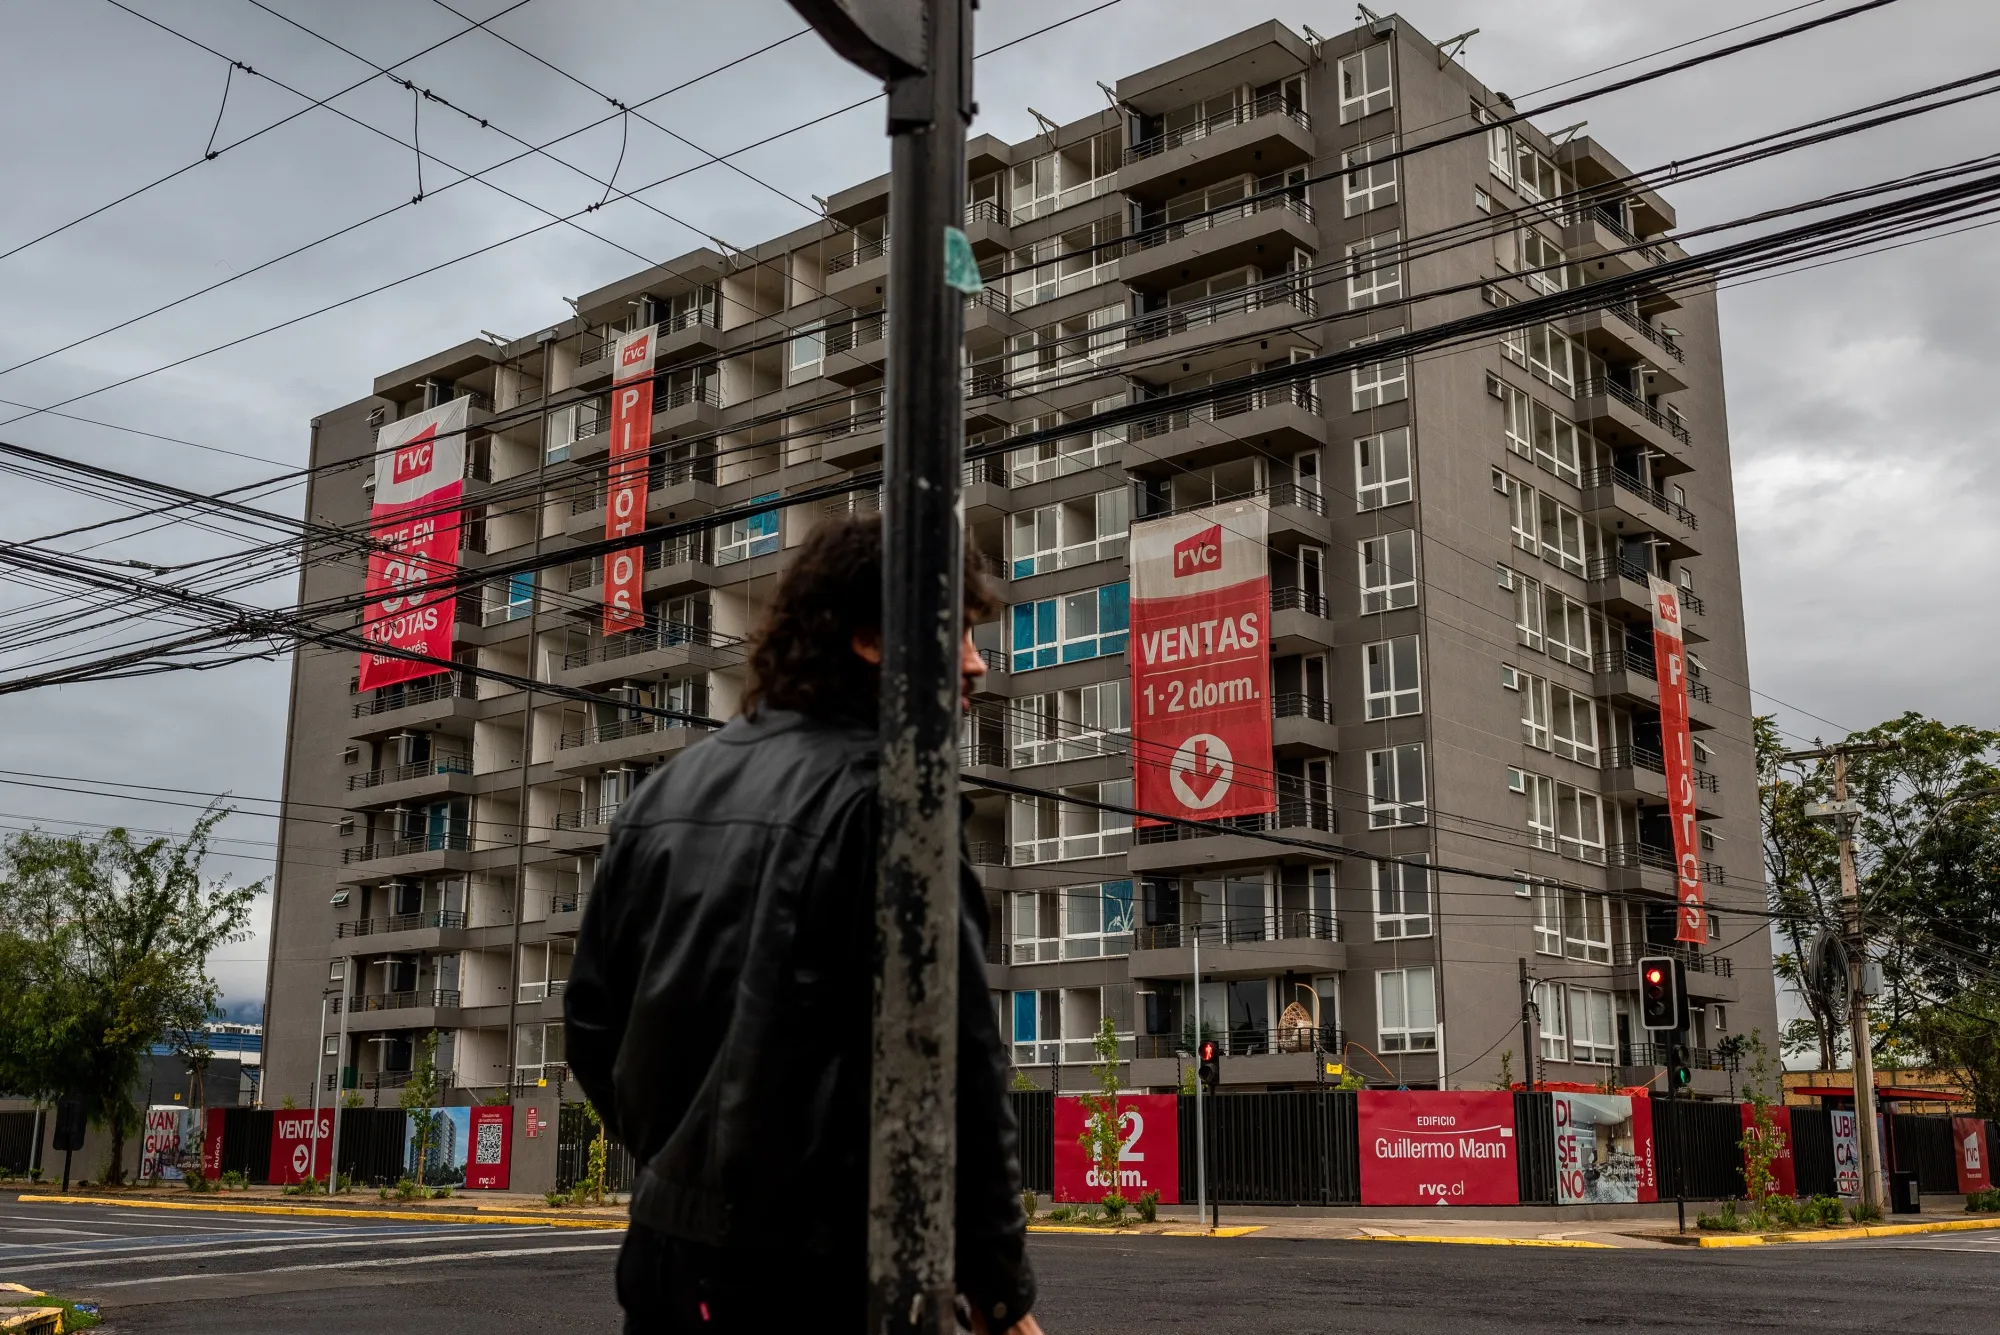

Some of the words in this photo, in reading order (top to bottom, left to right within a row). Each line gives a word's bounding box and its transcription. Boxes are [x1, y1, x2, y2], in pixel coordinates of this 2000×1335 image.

[624, 345, 645, 362] rvc
[397, 444, 431, 475] rvc
[412, 519, 435, 547] EN
[1178, 544, 1218, 570] rvc
[1660, 602, 1678, 619] rvc
[370, 607, 438, 643] CUOTAS
[1141, 612, 1259, 666] VENTAS
[1189, 677, 1260, 709] dorm.
[148, 1111, 175, 1131] VAN
[1417, 1116, 1456, 1126] EDIFICIO
[1555, 1099, 1572, 1128] DI
[278, 1118, 330, 1139] VENTAS
[1833, 1115, 1854, 1138] UBI
[145, 1134, 181, 1154] GUAR
[1375, 1137, 1455, 1159] Guillermo
[1459, 1137, 1506, 1159] Mann
[1557, 1134, 1578, 1164] SE
[1836, 1143, 1854, 1165] CA
[1966, 1147, 1979, 1162] rvc
[1645, 1137, 1654, 1187] ÑUÑOA
[478, 1176, 496, 1185] rvc.cl
[1085, 1165, 1148, 1187] dorm.
[1559, 1162, 1585, 1199] ÑO
[1419, 1180, 1464, 1196] rvc.cl
